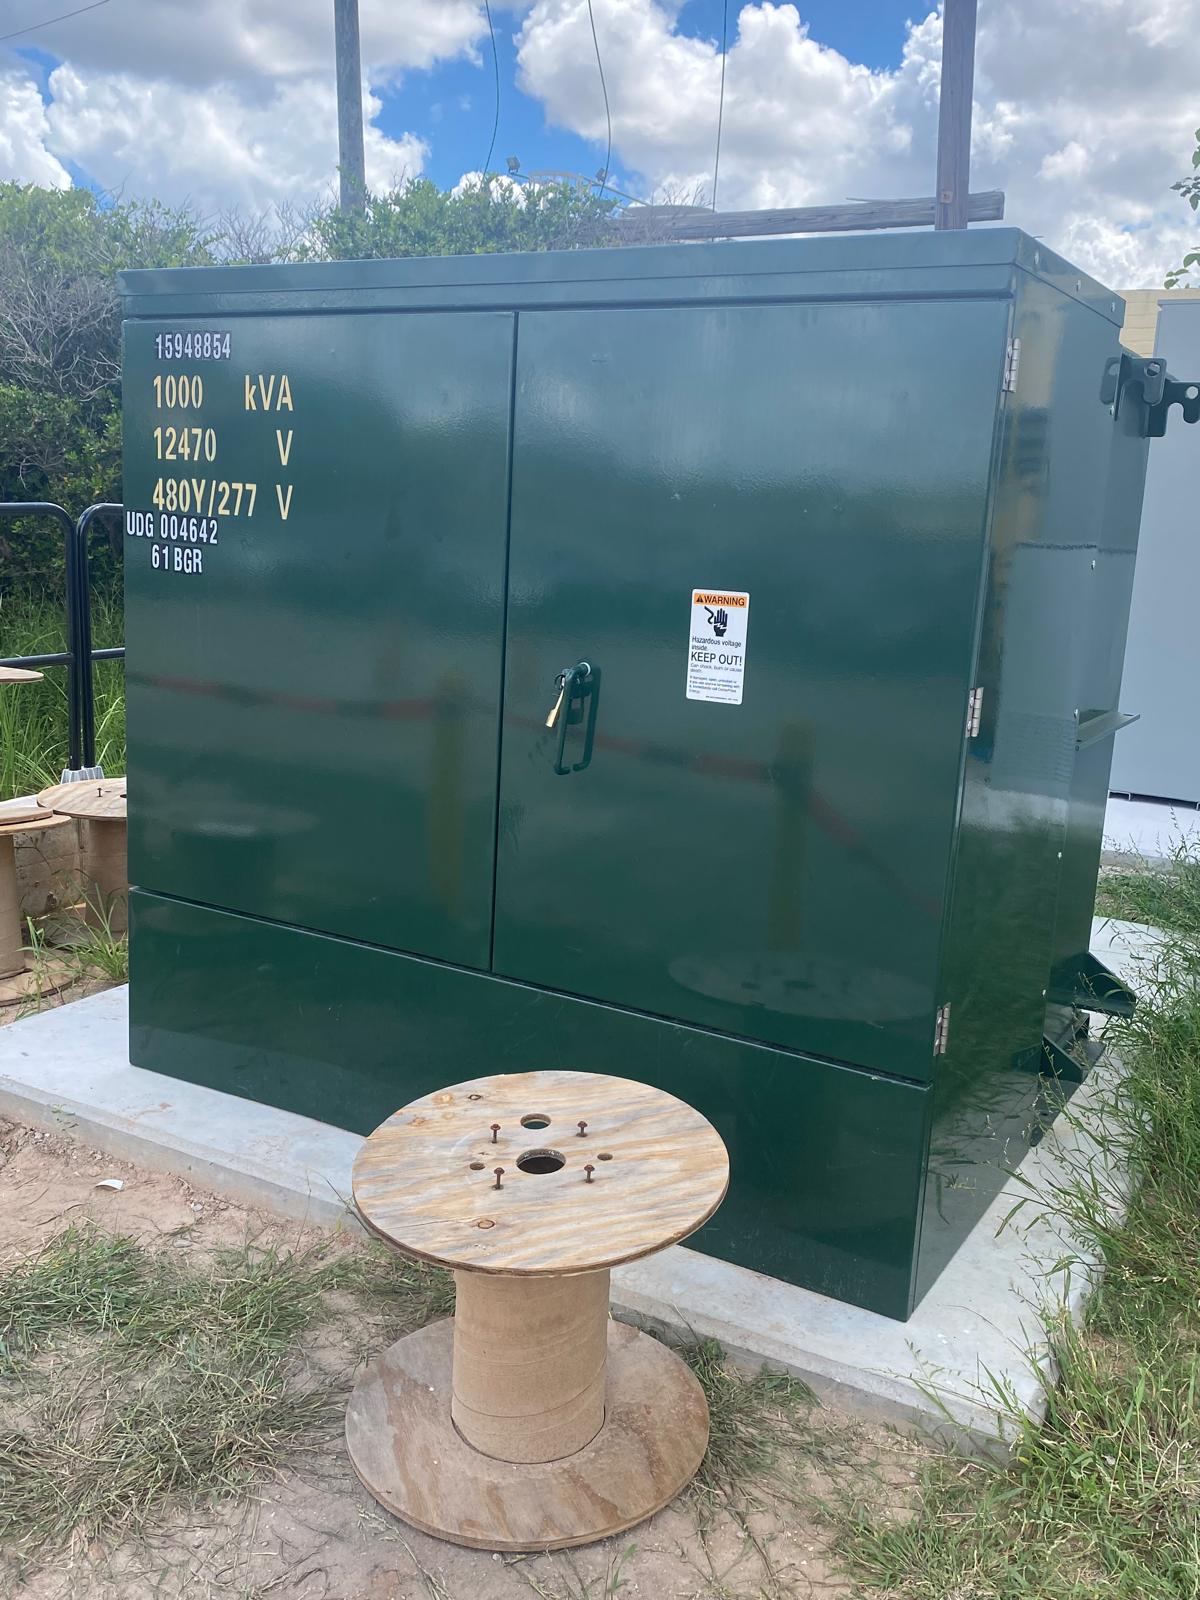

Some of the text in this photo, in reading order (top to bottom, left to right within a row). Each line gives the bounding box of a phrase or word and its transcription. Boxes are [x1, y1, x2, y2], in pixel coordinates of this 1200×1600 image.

[155, 332, 232, 360] 15948854
[153, 374, 294, 412] 1000 kVA
[153, 426, 294, 467] 12470 V
[152, 477, 294, 521] 480Y/277 V
[126, 511, 219, 546] UDG 004642
[704, 595, 745, 607] WARNING
[691, 636, 742, 649] Hazardous voltage
[690, 651, 743, 667] KEEP OUT!
